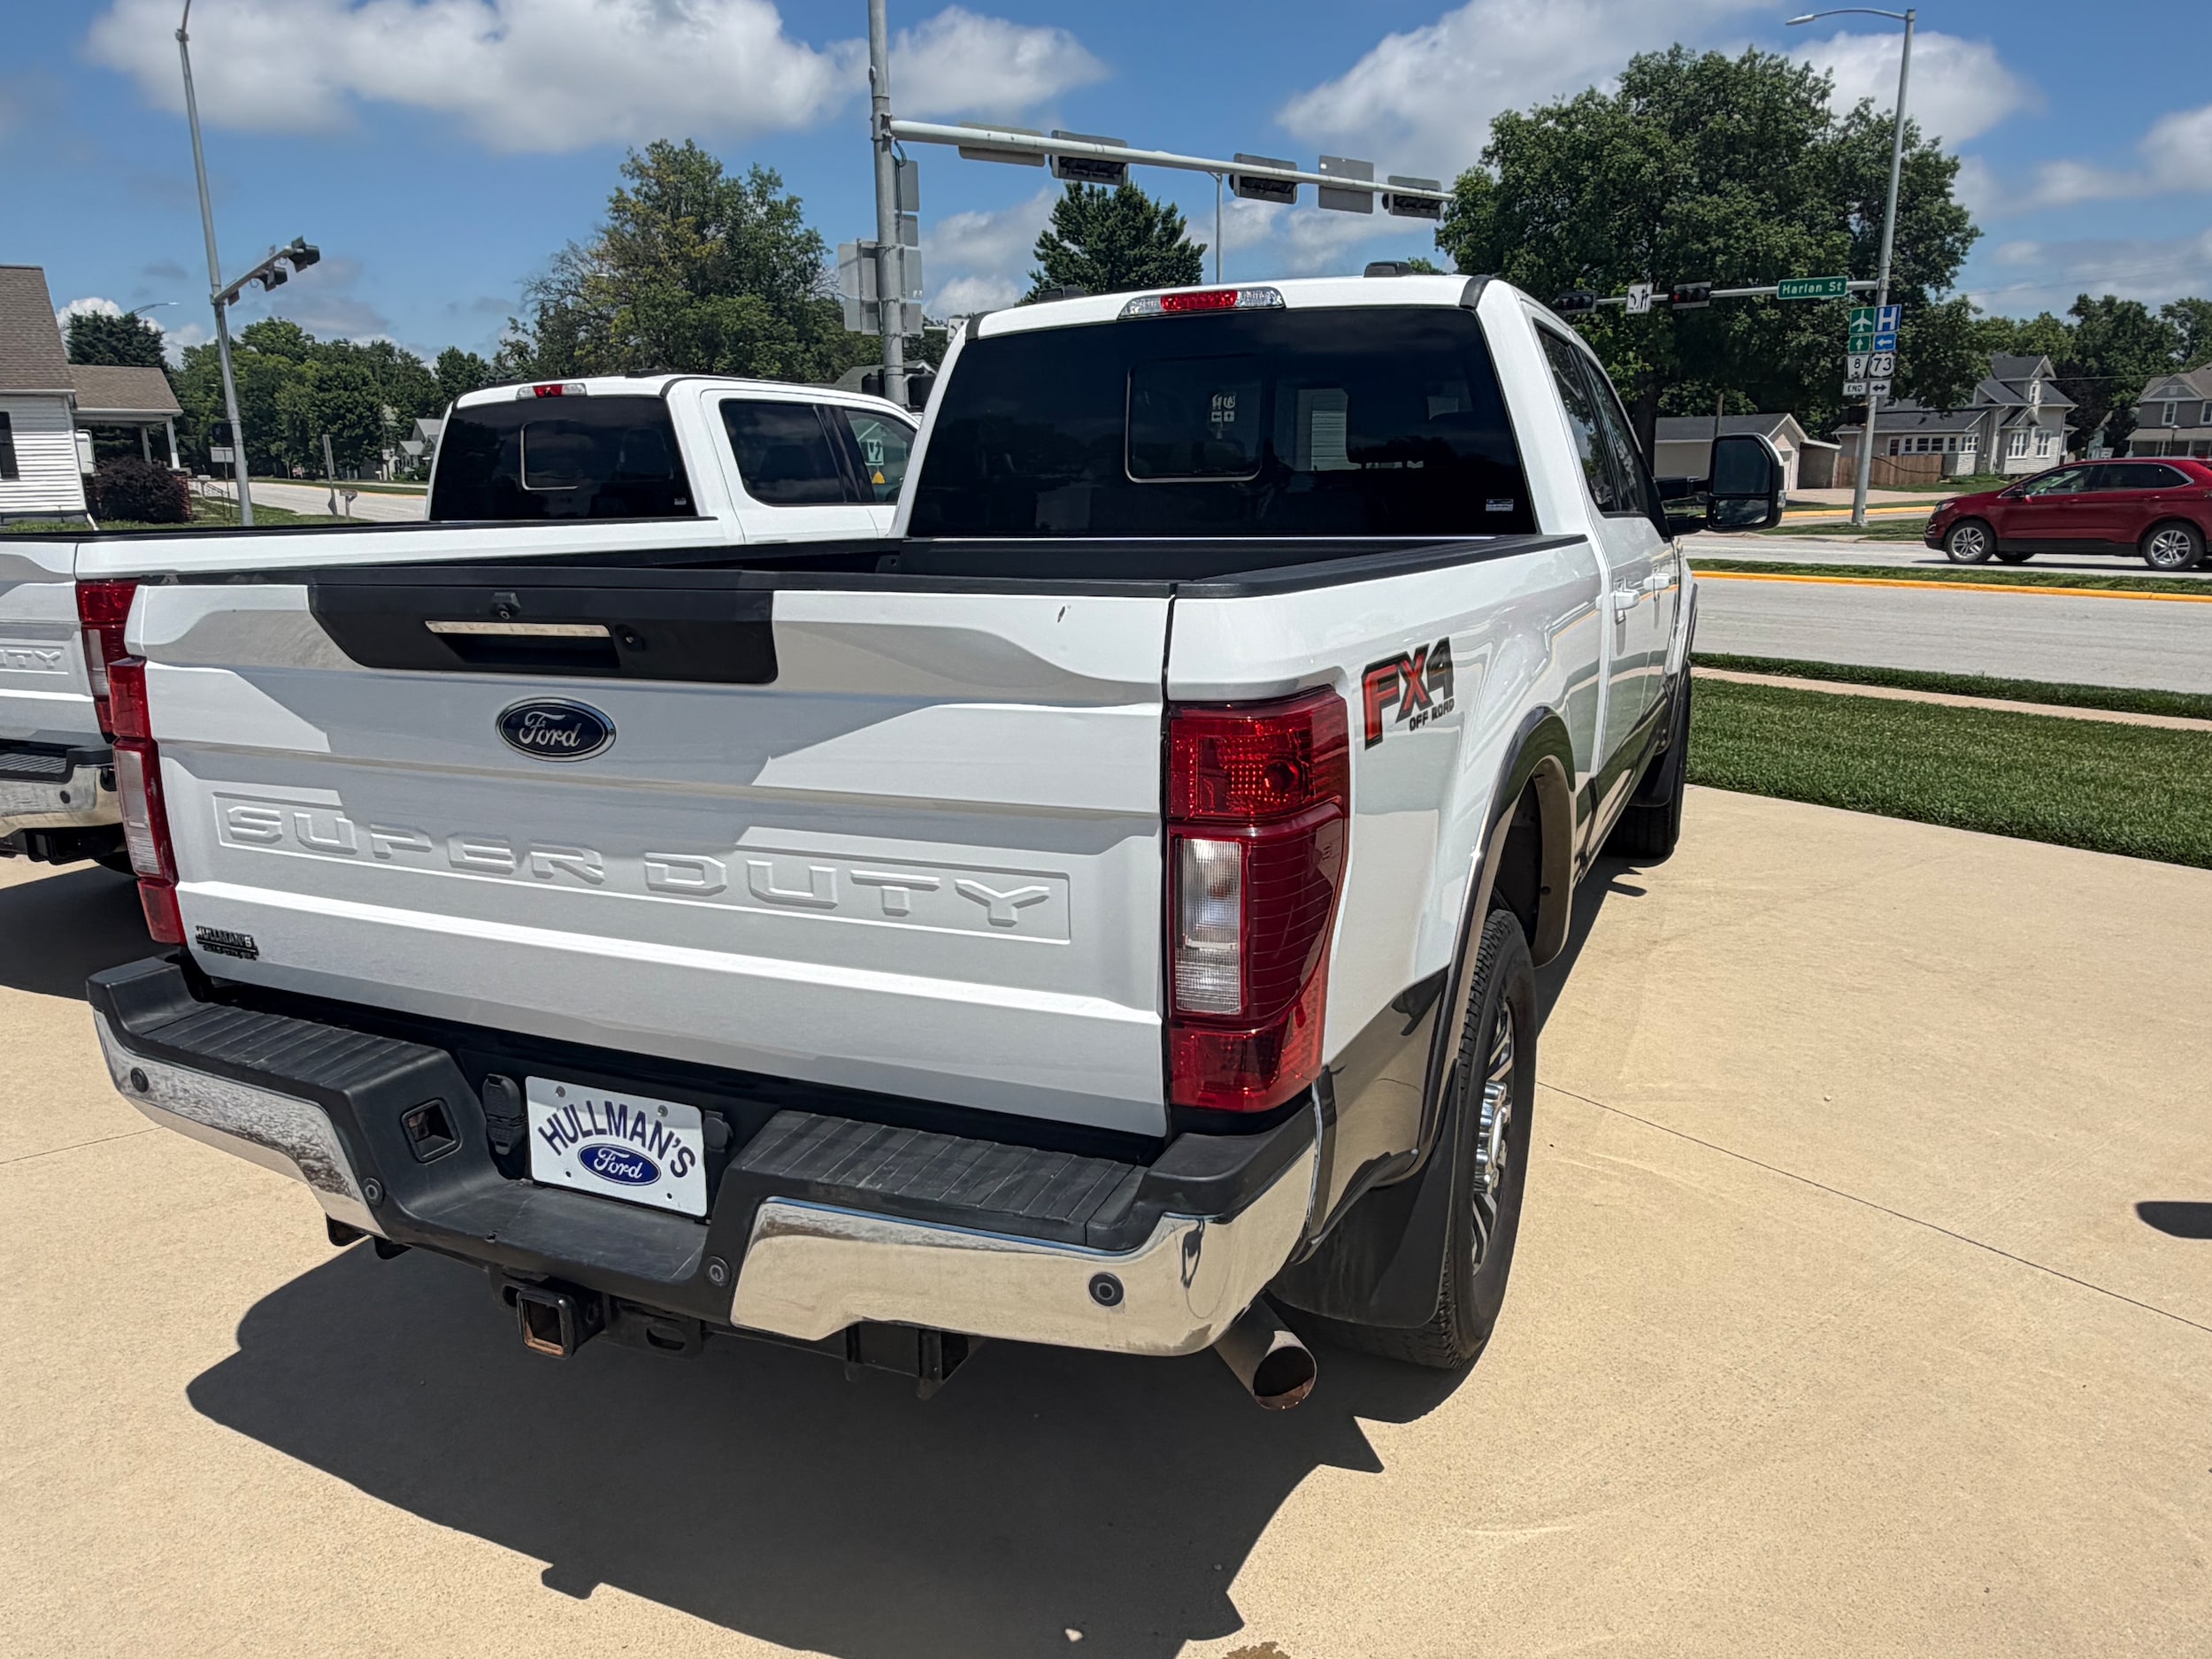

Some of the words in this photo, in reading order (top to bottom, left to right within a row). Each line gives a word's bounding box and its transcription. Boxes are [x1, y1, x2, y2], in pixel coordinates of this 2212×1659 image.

[1782, 283, 1823, 295] Harlan
[1829, 281, 1842, 292] St
[1877, 307, 1897, 331] H
[1854, 358, 1861, 369] 8
[1873, 357, 1892, 372] 73
[1361, 636, 1455, 751] FX4
[518, 710, 582, 747] Ford
[1409, 710, 1428, 732] OFF
[1432, 697, 1455, 721] ROAD
[227, 805, 605, 885] SUPER
[643, 852, 1051, 927] DUTY
[538, 1100, 696, 1178] HULLMAN'S
[593, 1147, 644, 1179] Ford
